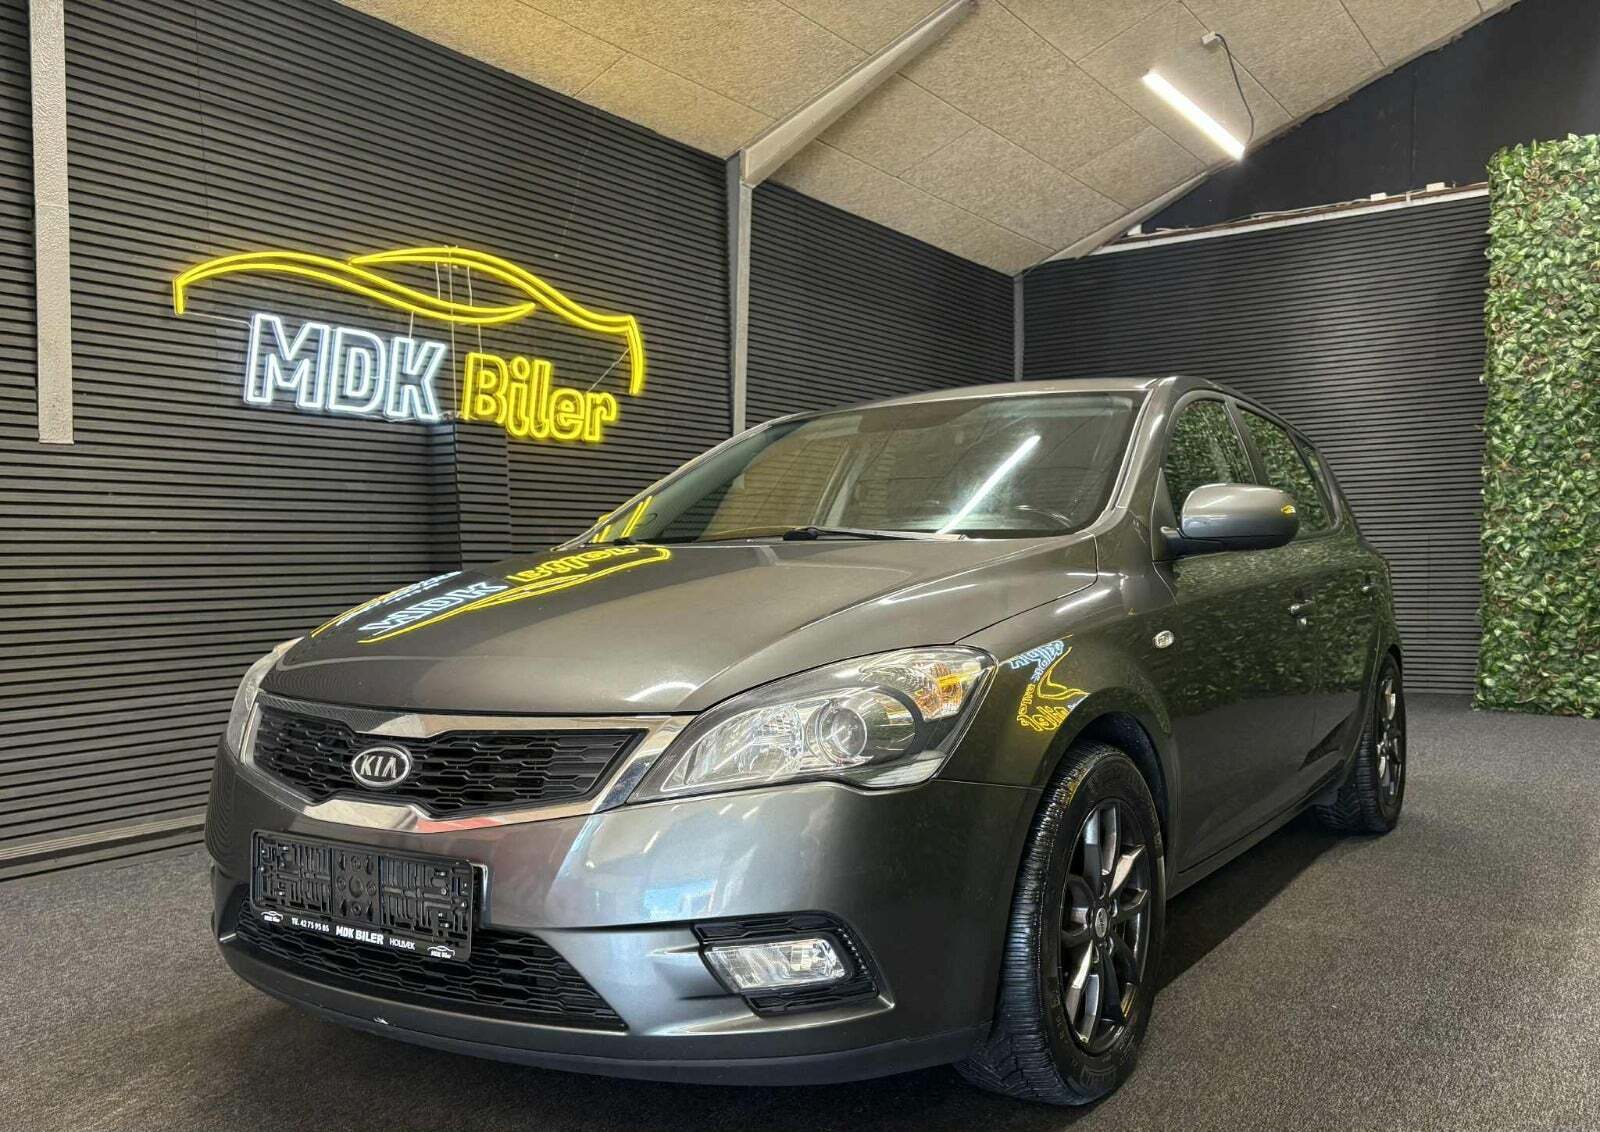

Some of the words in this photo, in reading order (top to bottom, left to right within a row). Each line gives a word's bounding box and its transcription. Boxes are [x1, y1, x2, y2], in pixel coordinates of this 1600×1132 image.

[243, 312, 448, 422] MDK
[462, 352, 618, 443] Biler
[360, 754, 397, 779] KIA
[335, 925, 355, 939] MDK
[355, 929, 384, 945] BILER
